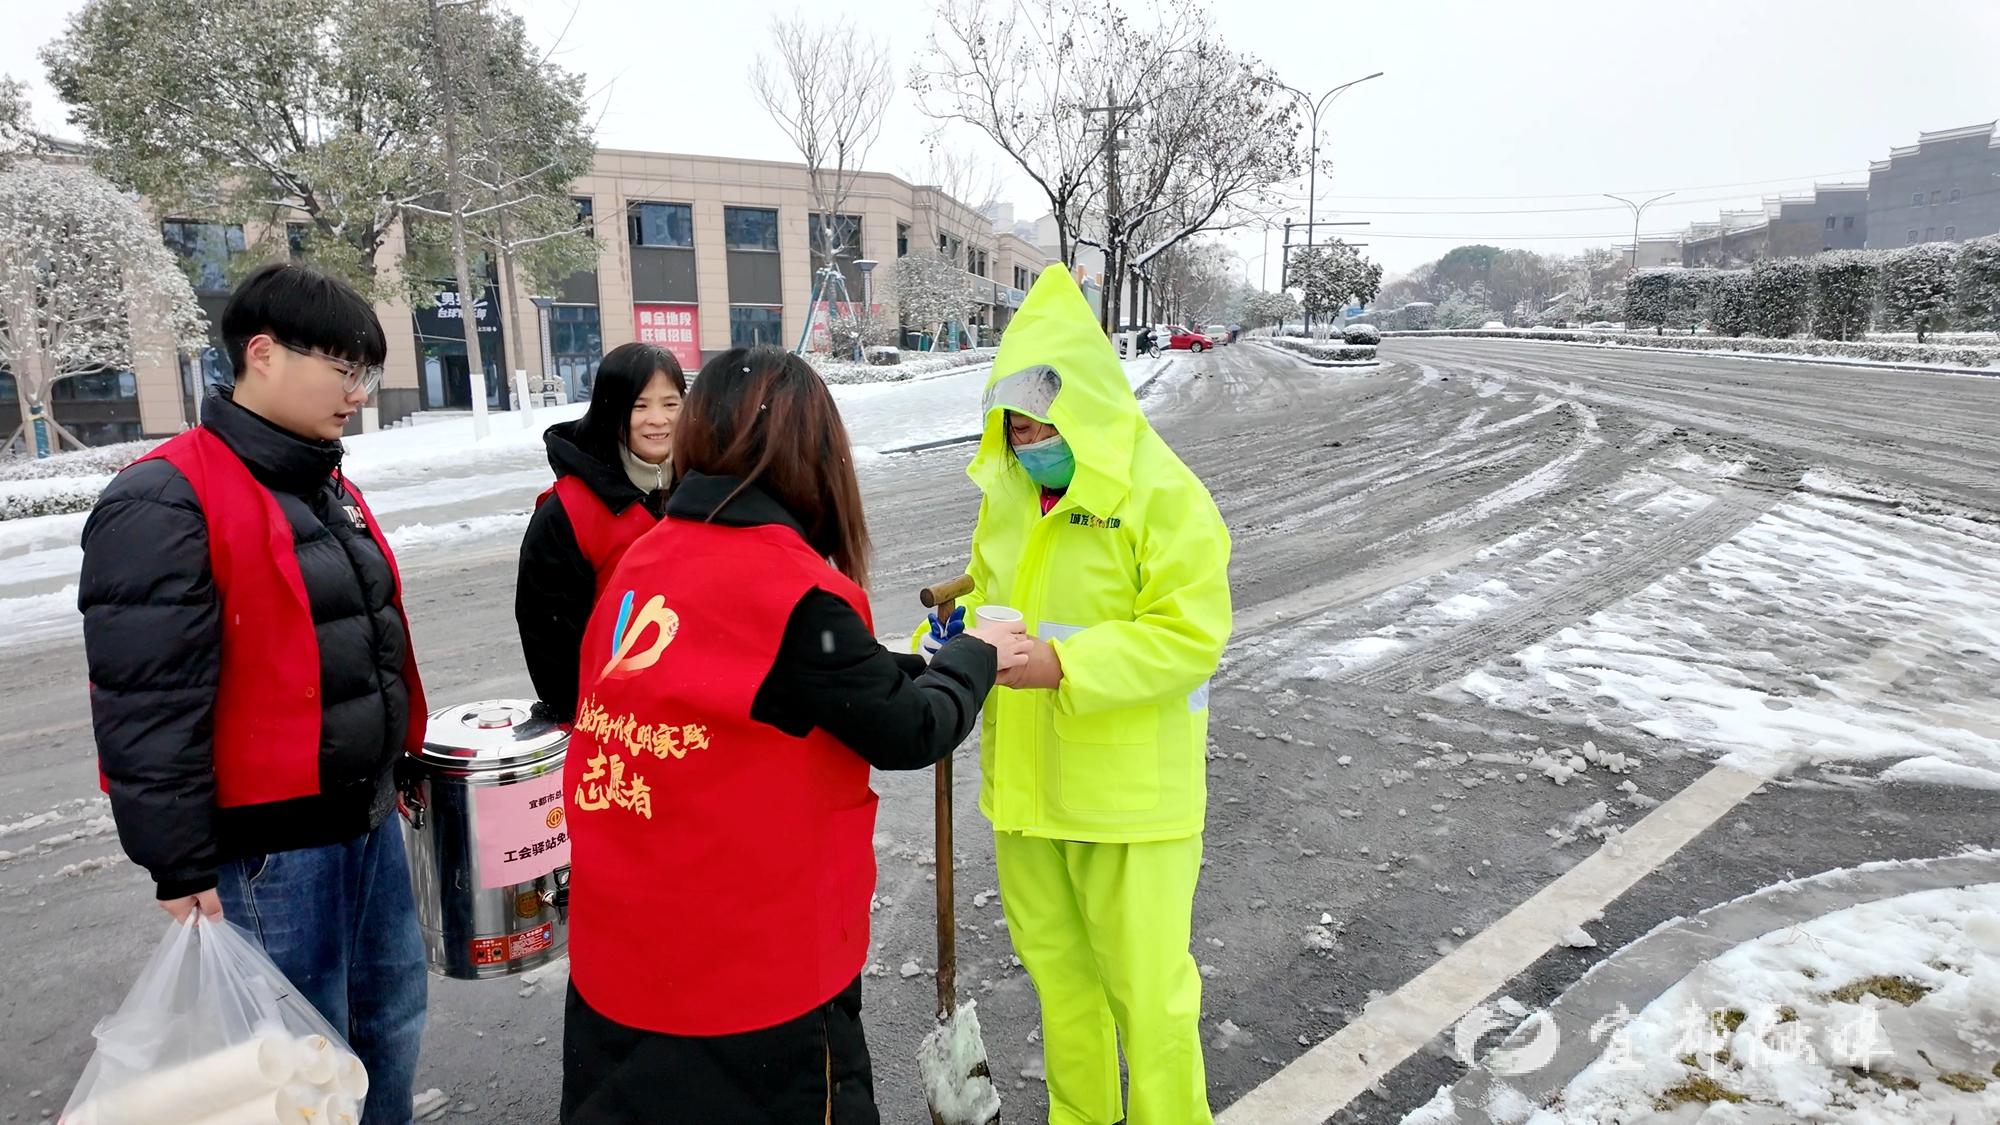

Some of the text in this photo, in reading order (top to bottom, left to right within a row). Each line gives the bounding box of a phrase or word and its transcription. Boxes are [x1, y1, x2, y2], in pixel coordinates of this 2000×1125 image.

[640, 311, 691, 326] 黄金地段
[641, 328, 693, 343] 旺铺招租
[574, 745, 652, 820] 志愿者
[503, 832, 570, 863] 工会驿站免
